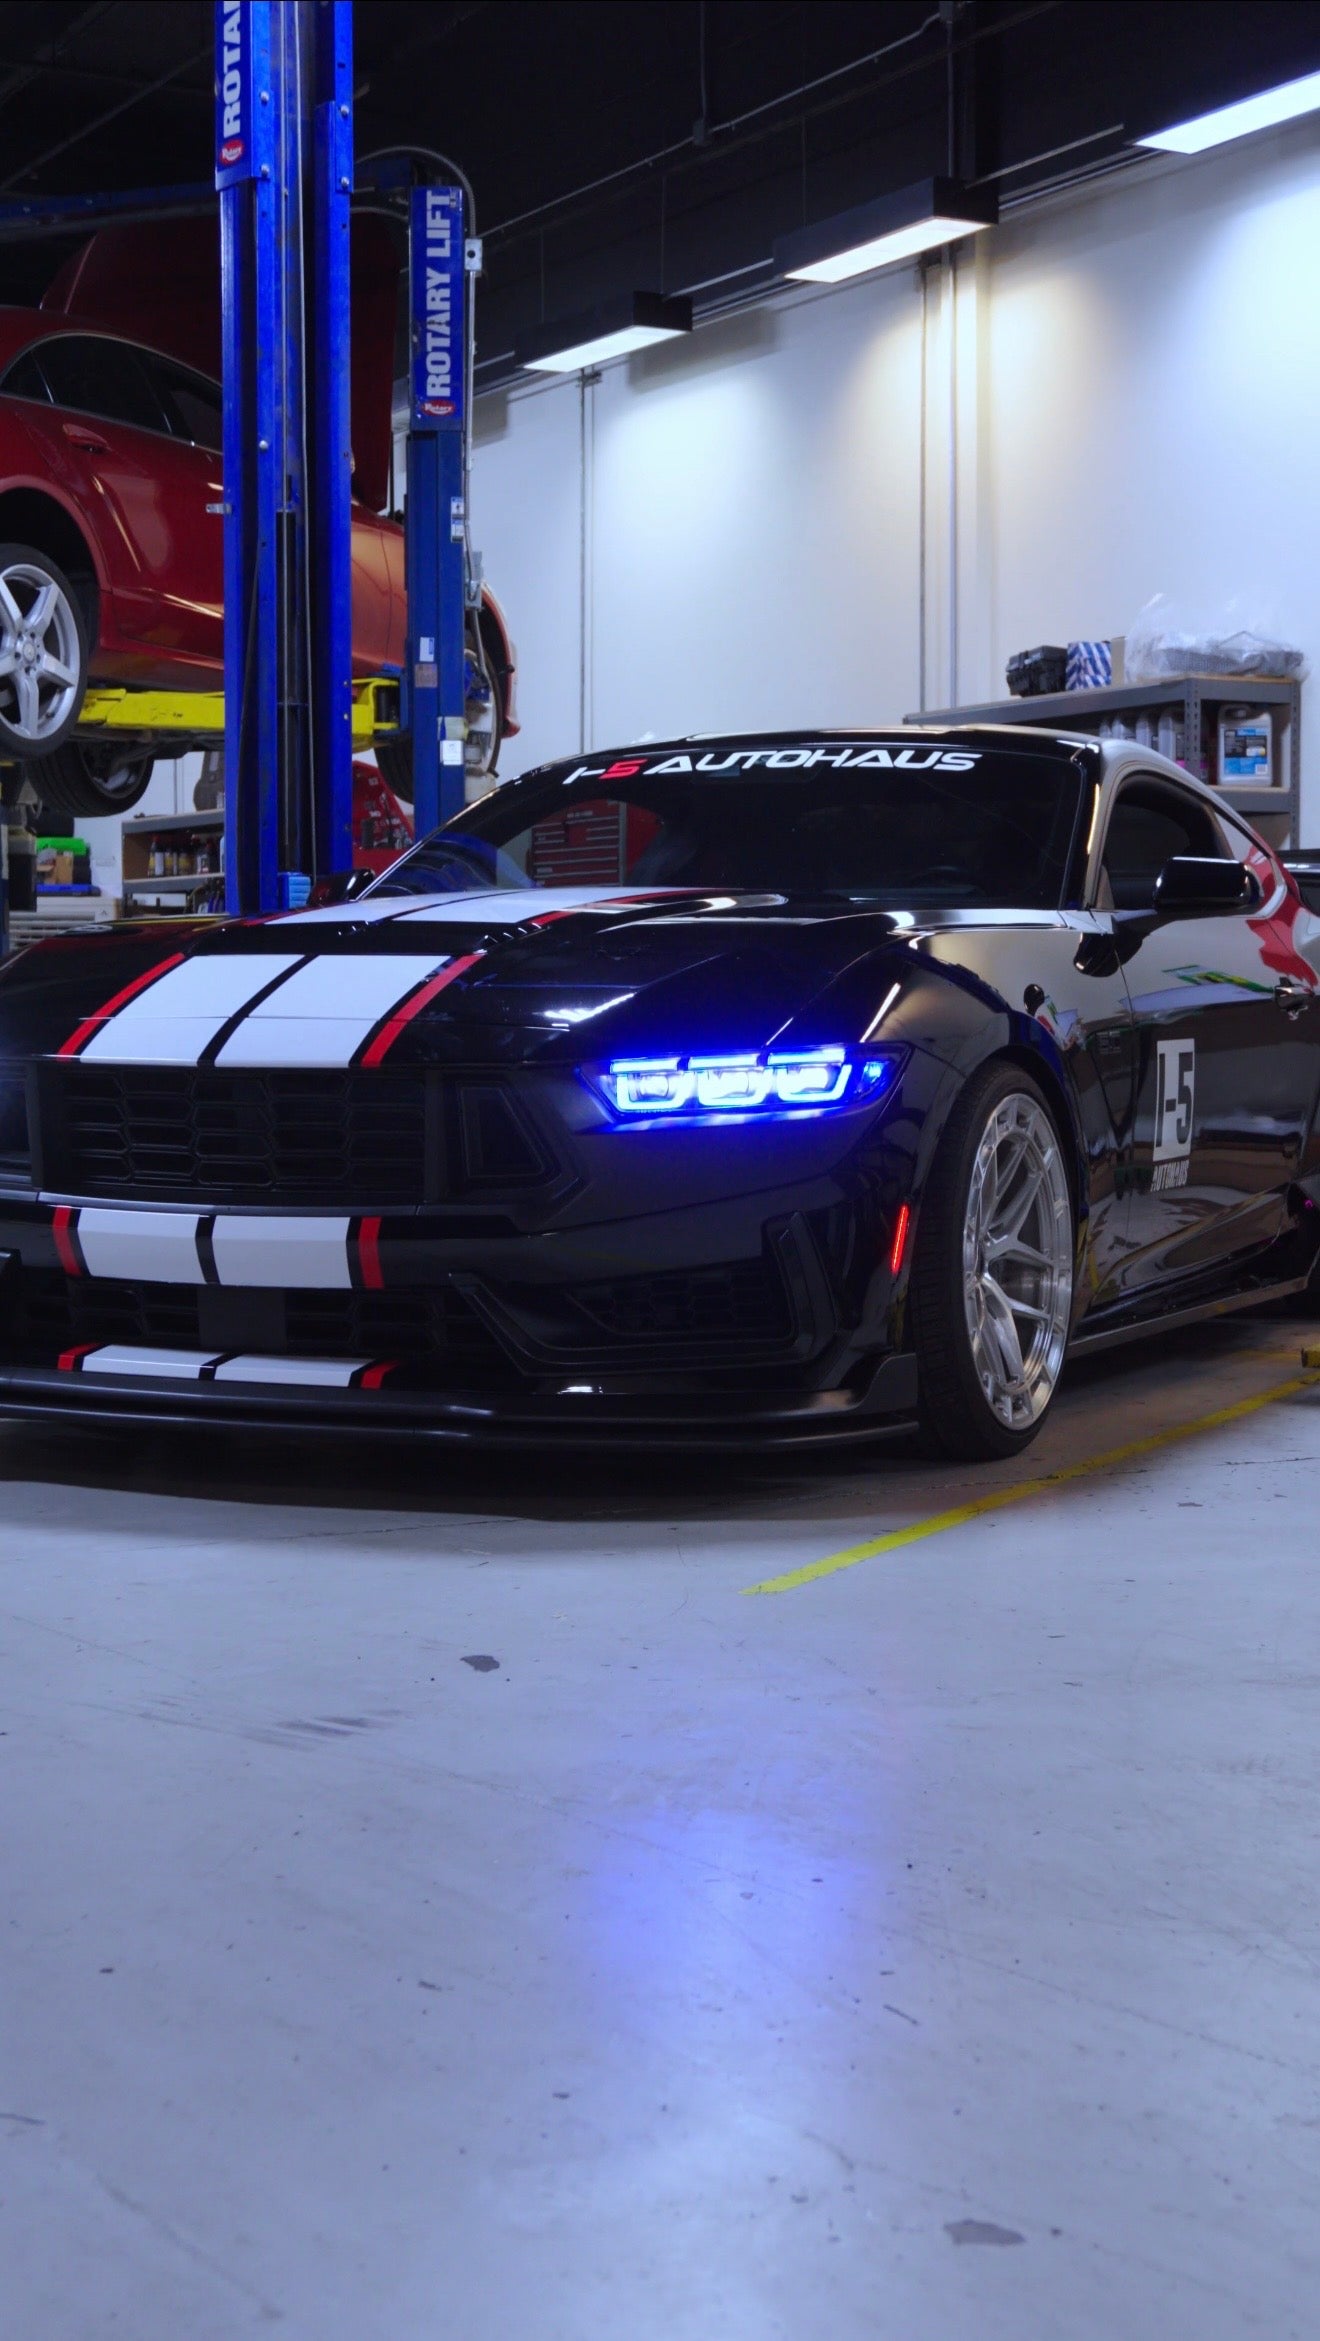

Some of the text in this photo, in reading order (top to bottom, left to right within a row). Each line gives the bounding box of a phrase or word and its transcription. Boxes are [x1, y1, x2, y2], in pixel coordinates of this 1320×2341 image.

[426, 190, 451, 397] ROTARY LIFT
[643, 749, 983, 776] AUTOHAUS
[1155, 1051, 1194, 1148] I-5
